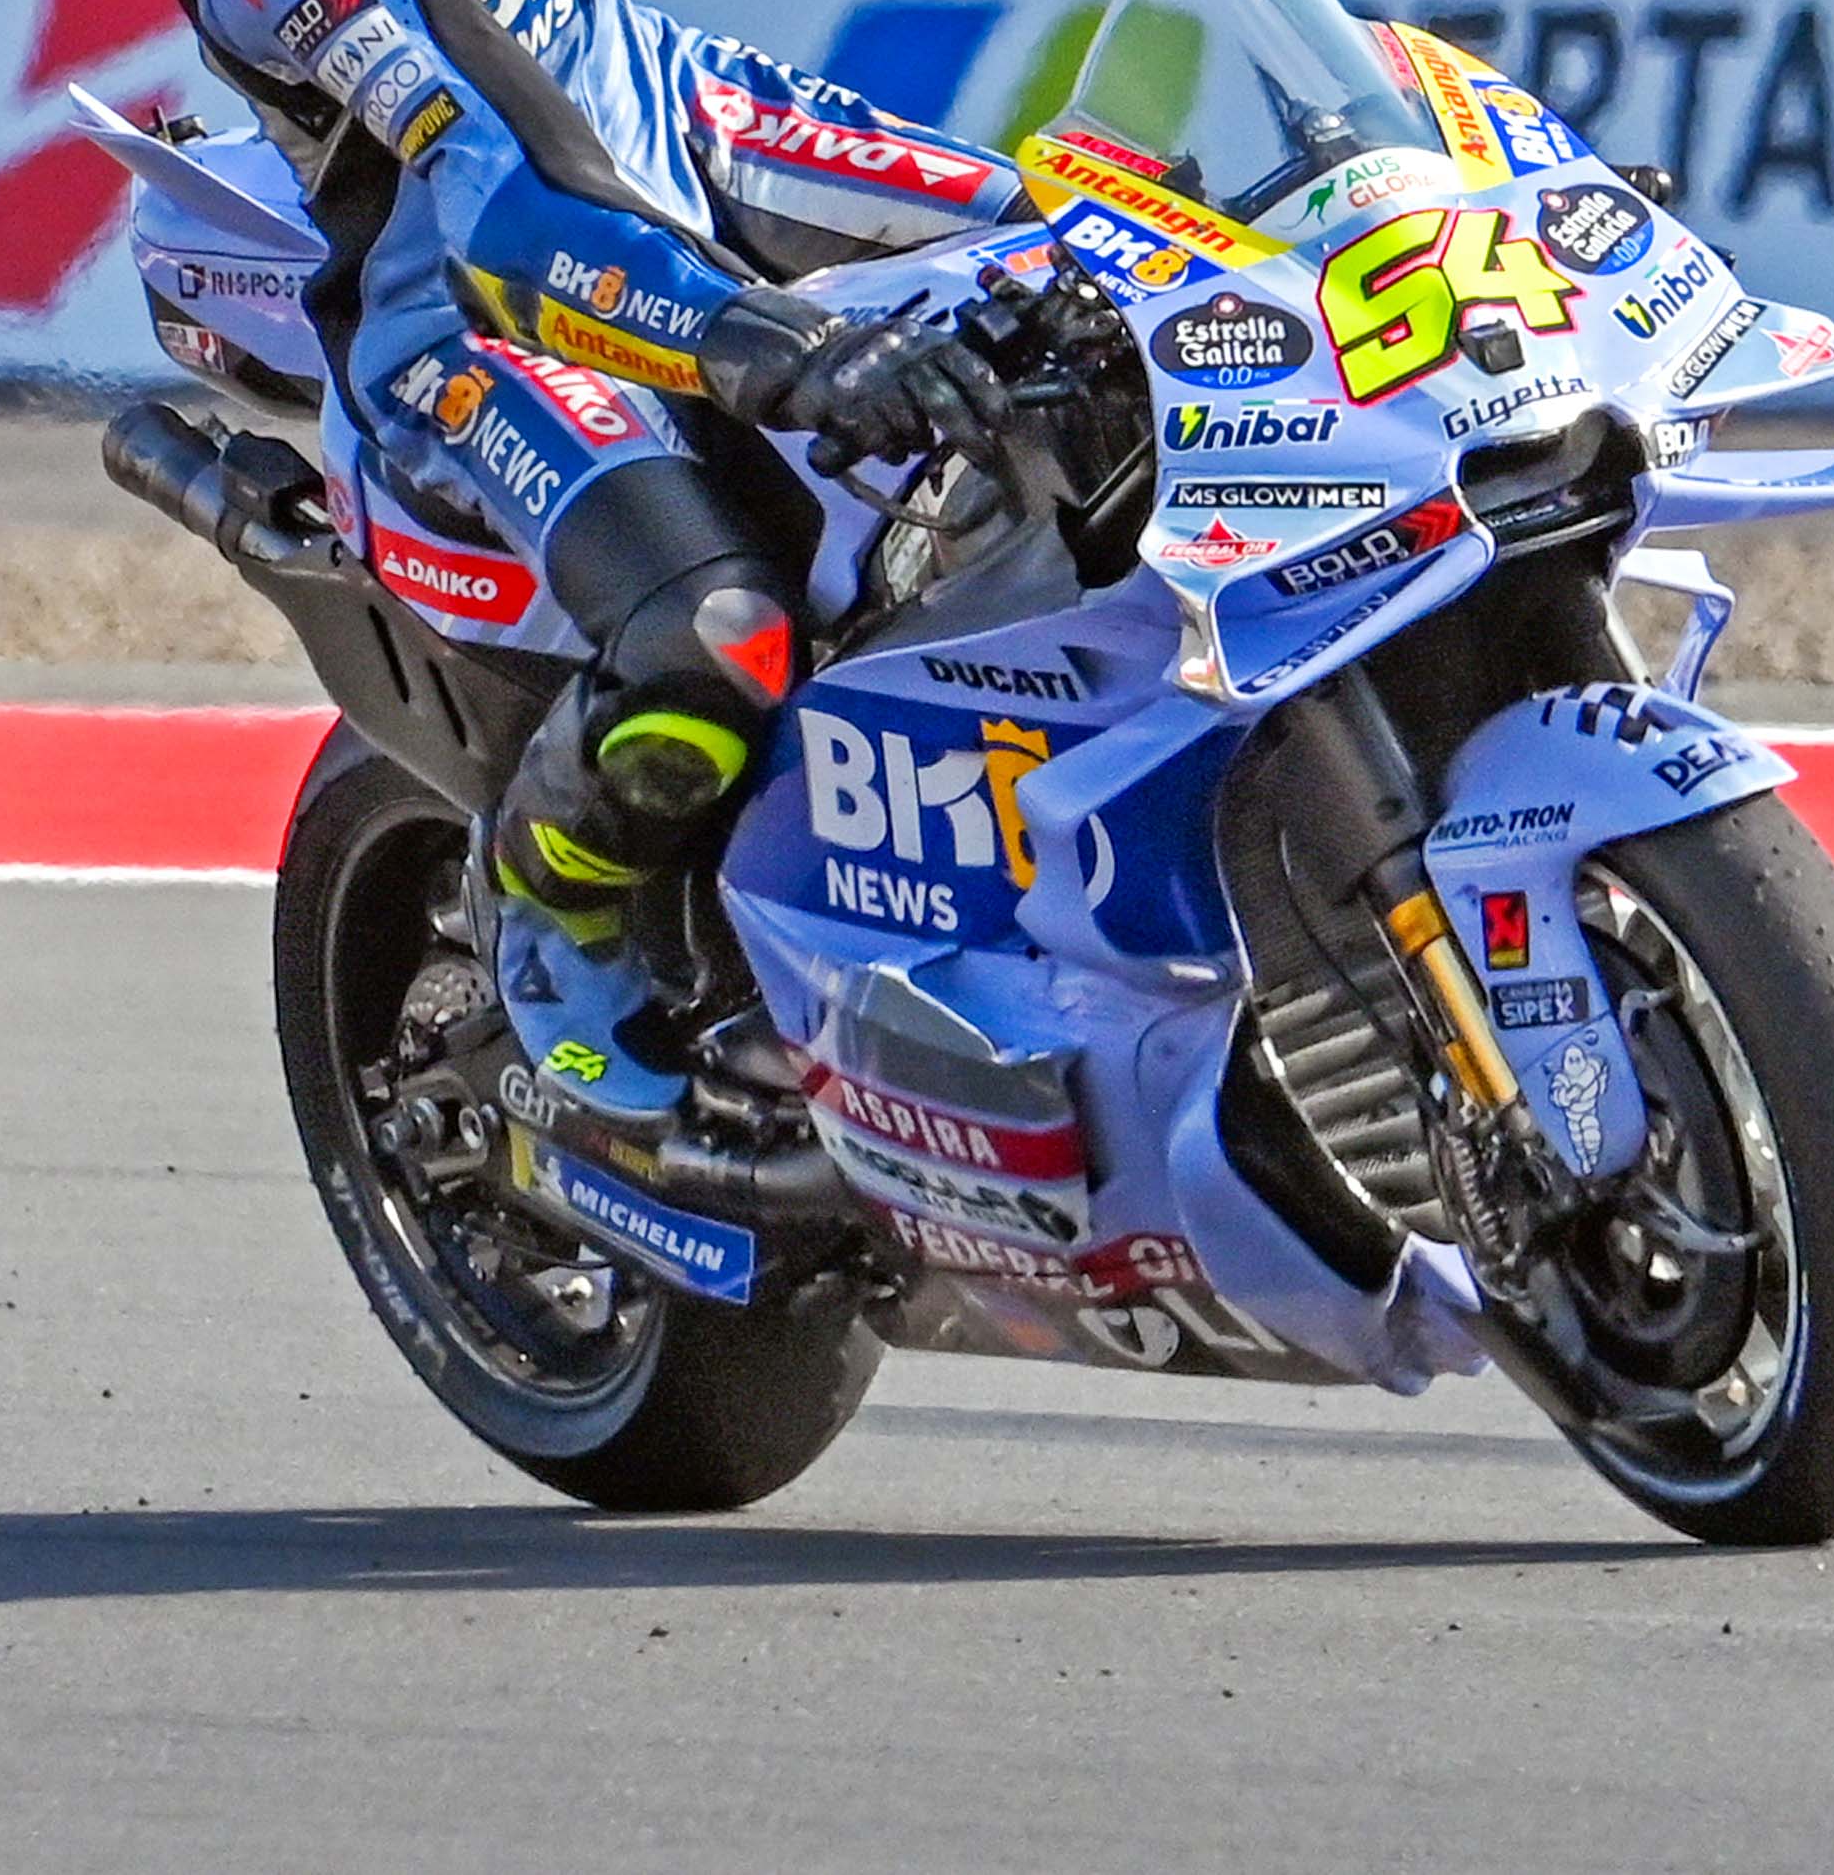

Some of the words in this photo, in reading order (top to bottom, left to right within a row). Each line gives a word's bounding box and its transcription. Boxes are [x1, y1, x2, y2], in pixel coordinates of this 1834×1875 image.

[1038, 152, 1235, 253] Antangin
[1346, 156, 1401, 188] AUS
[1064, 214, 1193, 293] BK8
[547, 251, 626, 319] BK8
[1095, 270, 1148, 304] NEWS
[1318, 209, 1581, 404] 54
[1612, 245, 1714, 340] Unibat
[1175, 316, 1286, 343] Estrella
[1181, 340, 1284, 368] Galicia
[1165, 404, 1341, 450] Unibat
[1443, 375, 1593, 440] Gigetta
[473, 407, 561, 516] NEWS
[1177, 485, 1216, 505] MS
[1221, 486, 1304, 506] GLOW
[1318, 487, 1382, 506] MEN
[408, 558, 498, 602] DAIKO
[1282, 529, 1400, 589] BOLD
[921, 657, 1080, 701] DUCATI
[826, 857, 958, 932] NEWS
[544, 1040, 606, 1082] 54
[839, 1080, 1000, 1167] ASPIRA
[571, 1183, 725, 1272] MICHELIN
